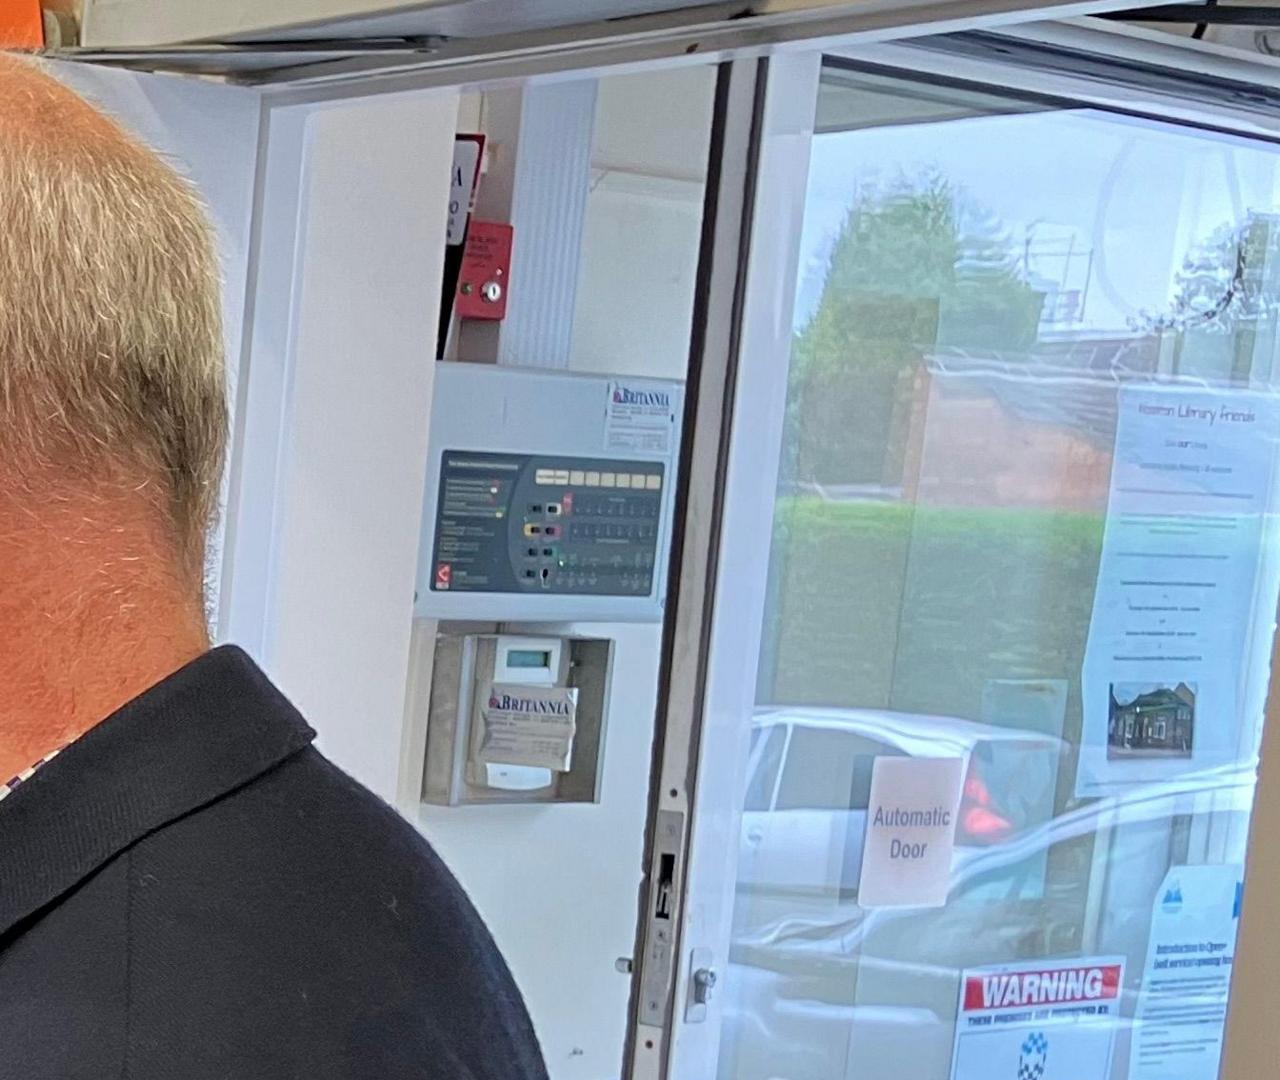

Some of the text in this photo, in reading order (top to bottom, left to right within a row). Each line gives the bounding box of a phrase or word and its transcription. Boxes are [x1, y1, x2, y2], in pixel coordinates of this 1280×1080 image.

[1178, 404, 1217, 427] Library
[1220, 404, 1256, 422] Friends
[500, 695, 569, 715] BRITANNIA
[873, 805, 951, 827] Automatic
[890, 838, 927, 859] Door
[982, 968, 1103, 1008] WARNING
[968, 1016, 991, 1027] THESE
[993, 1011, 1032, 1024] PREMISES
